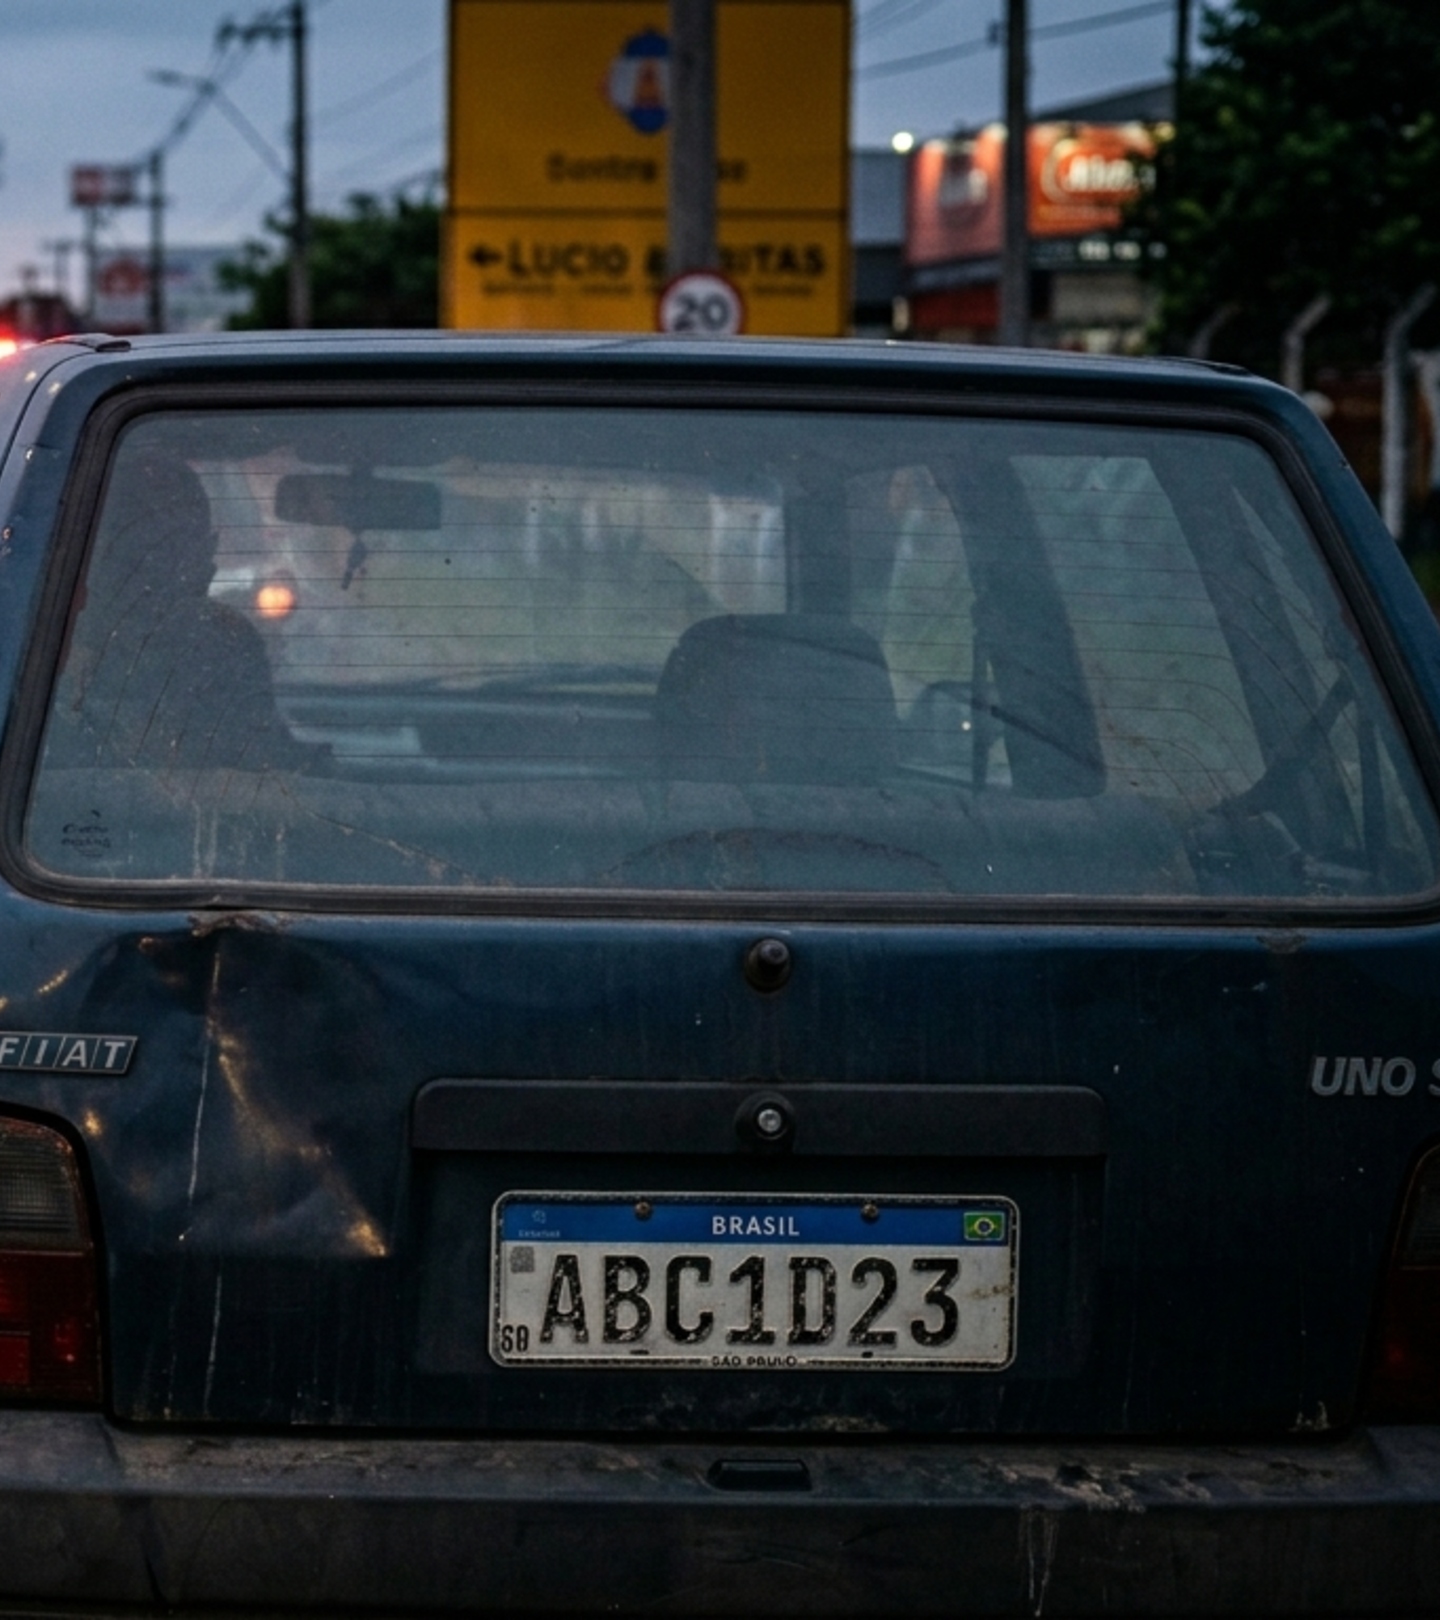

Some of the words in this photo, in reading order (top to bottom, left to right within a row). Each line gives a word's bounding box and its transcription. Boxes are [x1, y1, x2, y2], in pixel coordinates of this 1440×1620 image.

[675, 295, 730, 332] 20
[1311, 1056, 1417, 1096] UNO
[712, 1215, 800, 1237] BRASIL
[539, 1253, 961, 1348] ABC1D23
